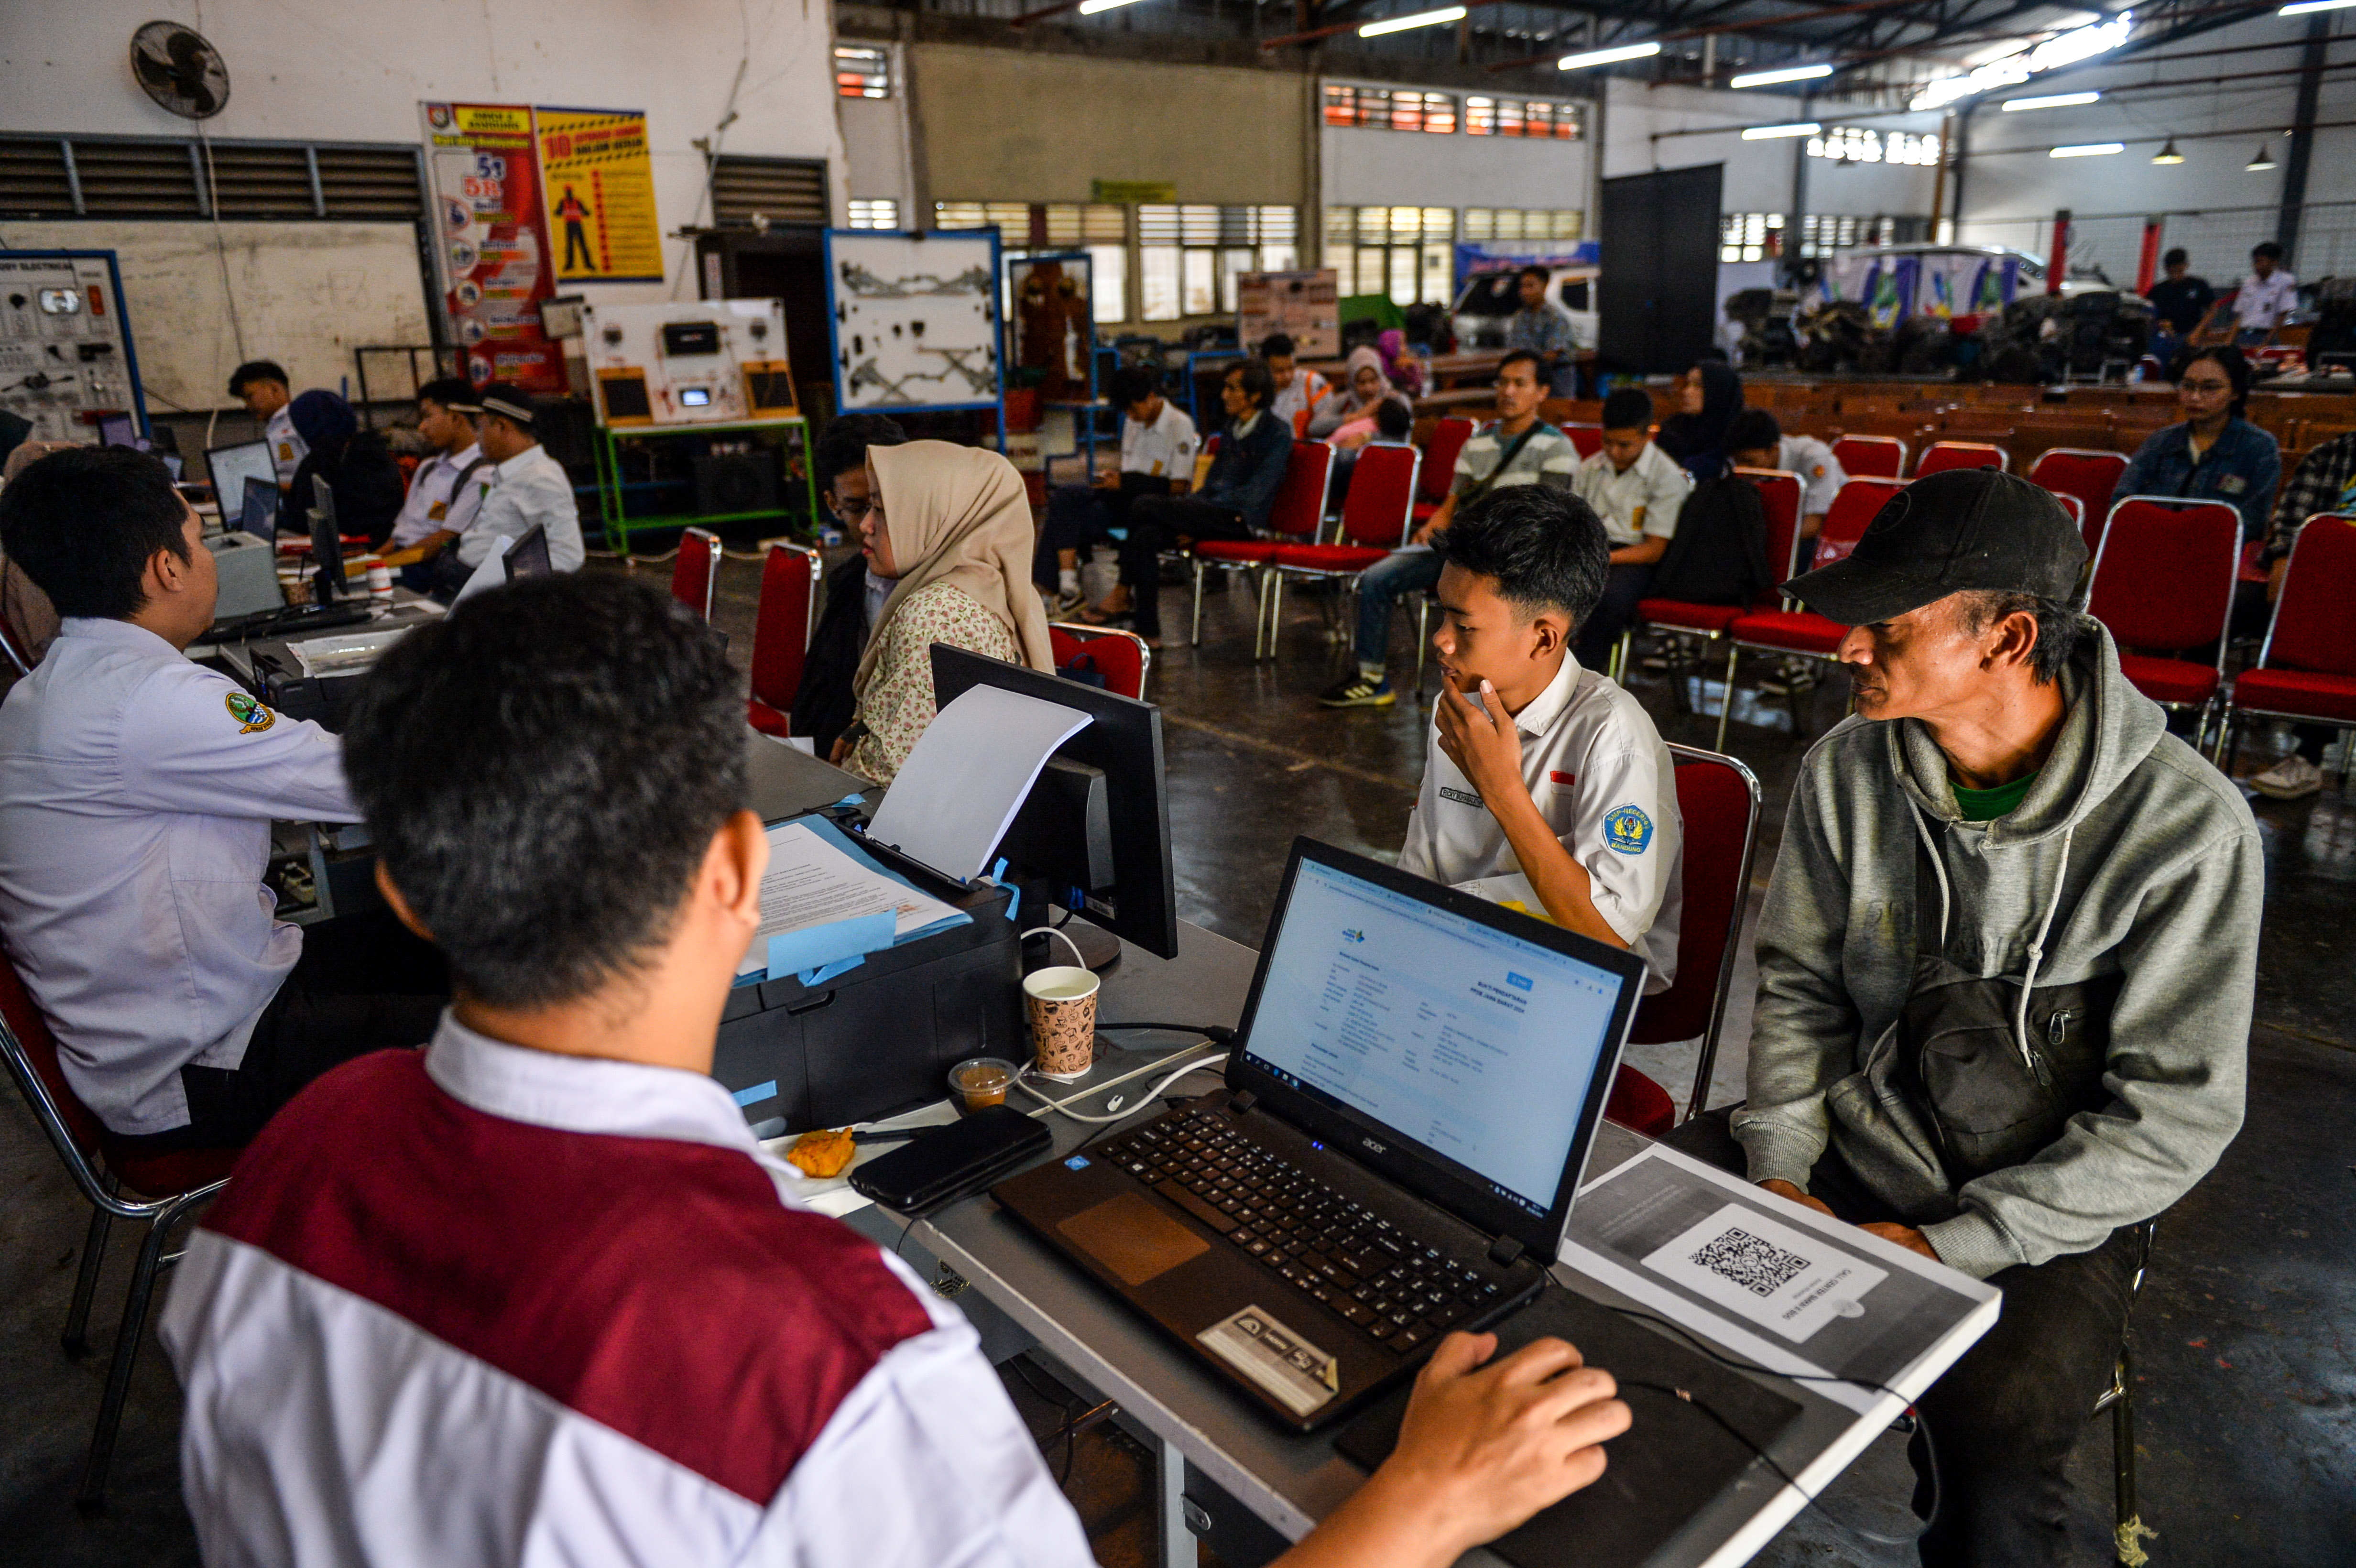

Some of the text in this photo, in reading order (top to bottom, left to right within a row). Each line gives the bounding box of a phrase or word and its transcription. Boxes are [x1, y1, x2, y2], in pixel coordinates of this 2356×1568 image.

[544, 134, 571, 159] 10
[1611, 843, 1641, 853] BANDUNG
[1363, 1137, 1386, 1154] acer
[1835, 1268, 1852, 1280] CALL
[1816, 1279, 1839, 1296] CENTER
